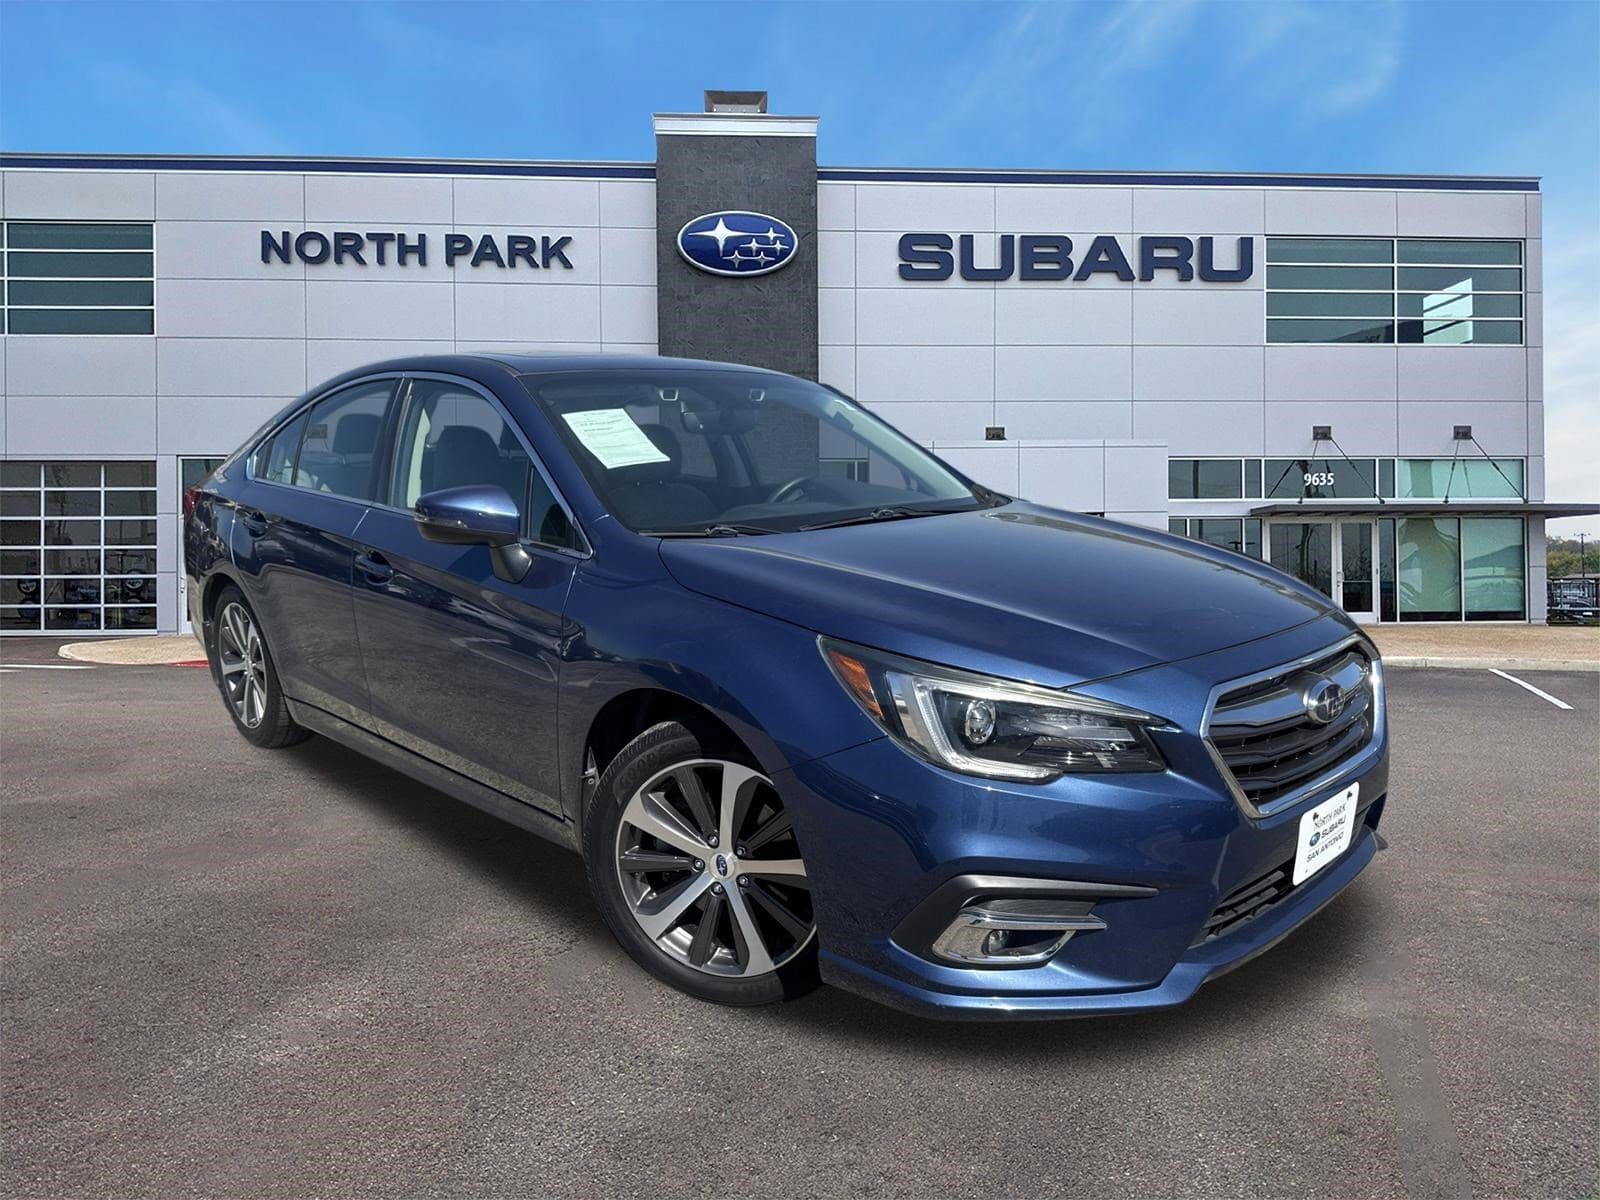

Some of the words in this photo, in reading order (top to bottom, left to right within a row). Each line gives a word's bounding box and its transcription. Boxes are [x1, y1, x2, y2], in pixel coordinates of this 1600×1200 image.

[260, 230, 427, 267] NORTH
[444, 233, 574, 269] PARK
[898, 233, 1254, 282] SUBARU
[1303, 472, 1335, 486] 9635
[1321, 815, 1346, 839] SUBARU
[1306, 849, 1320, 863] SAN
[1320, 831, 1345, 852] ANTONIO
